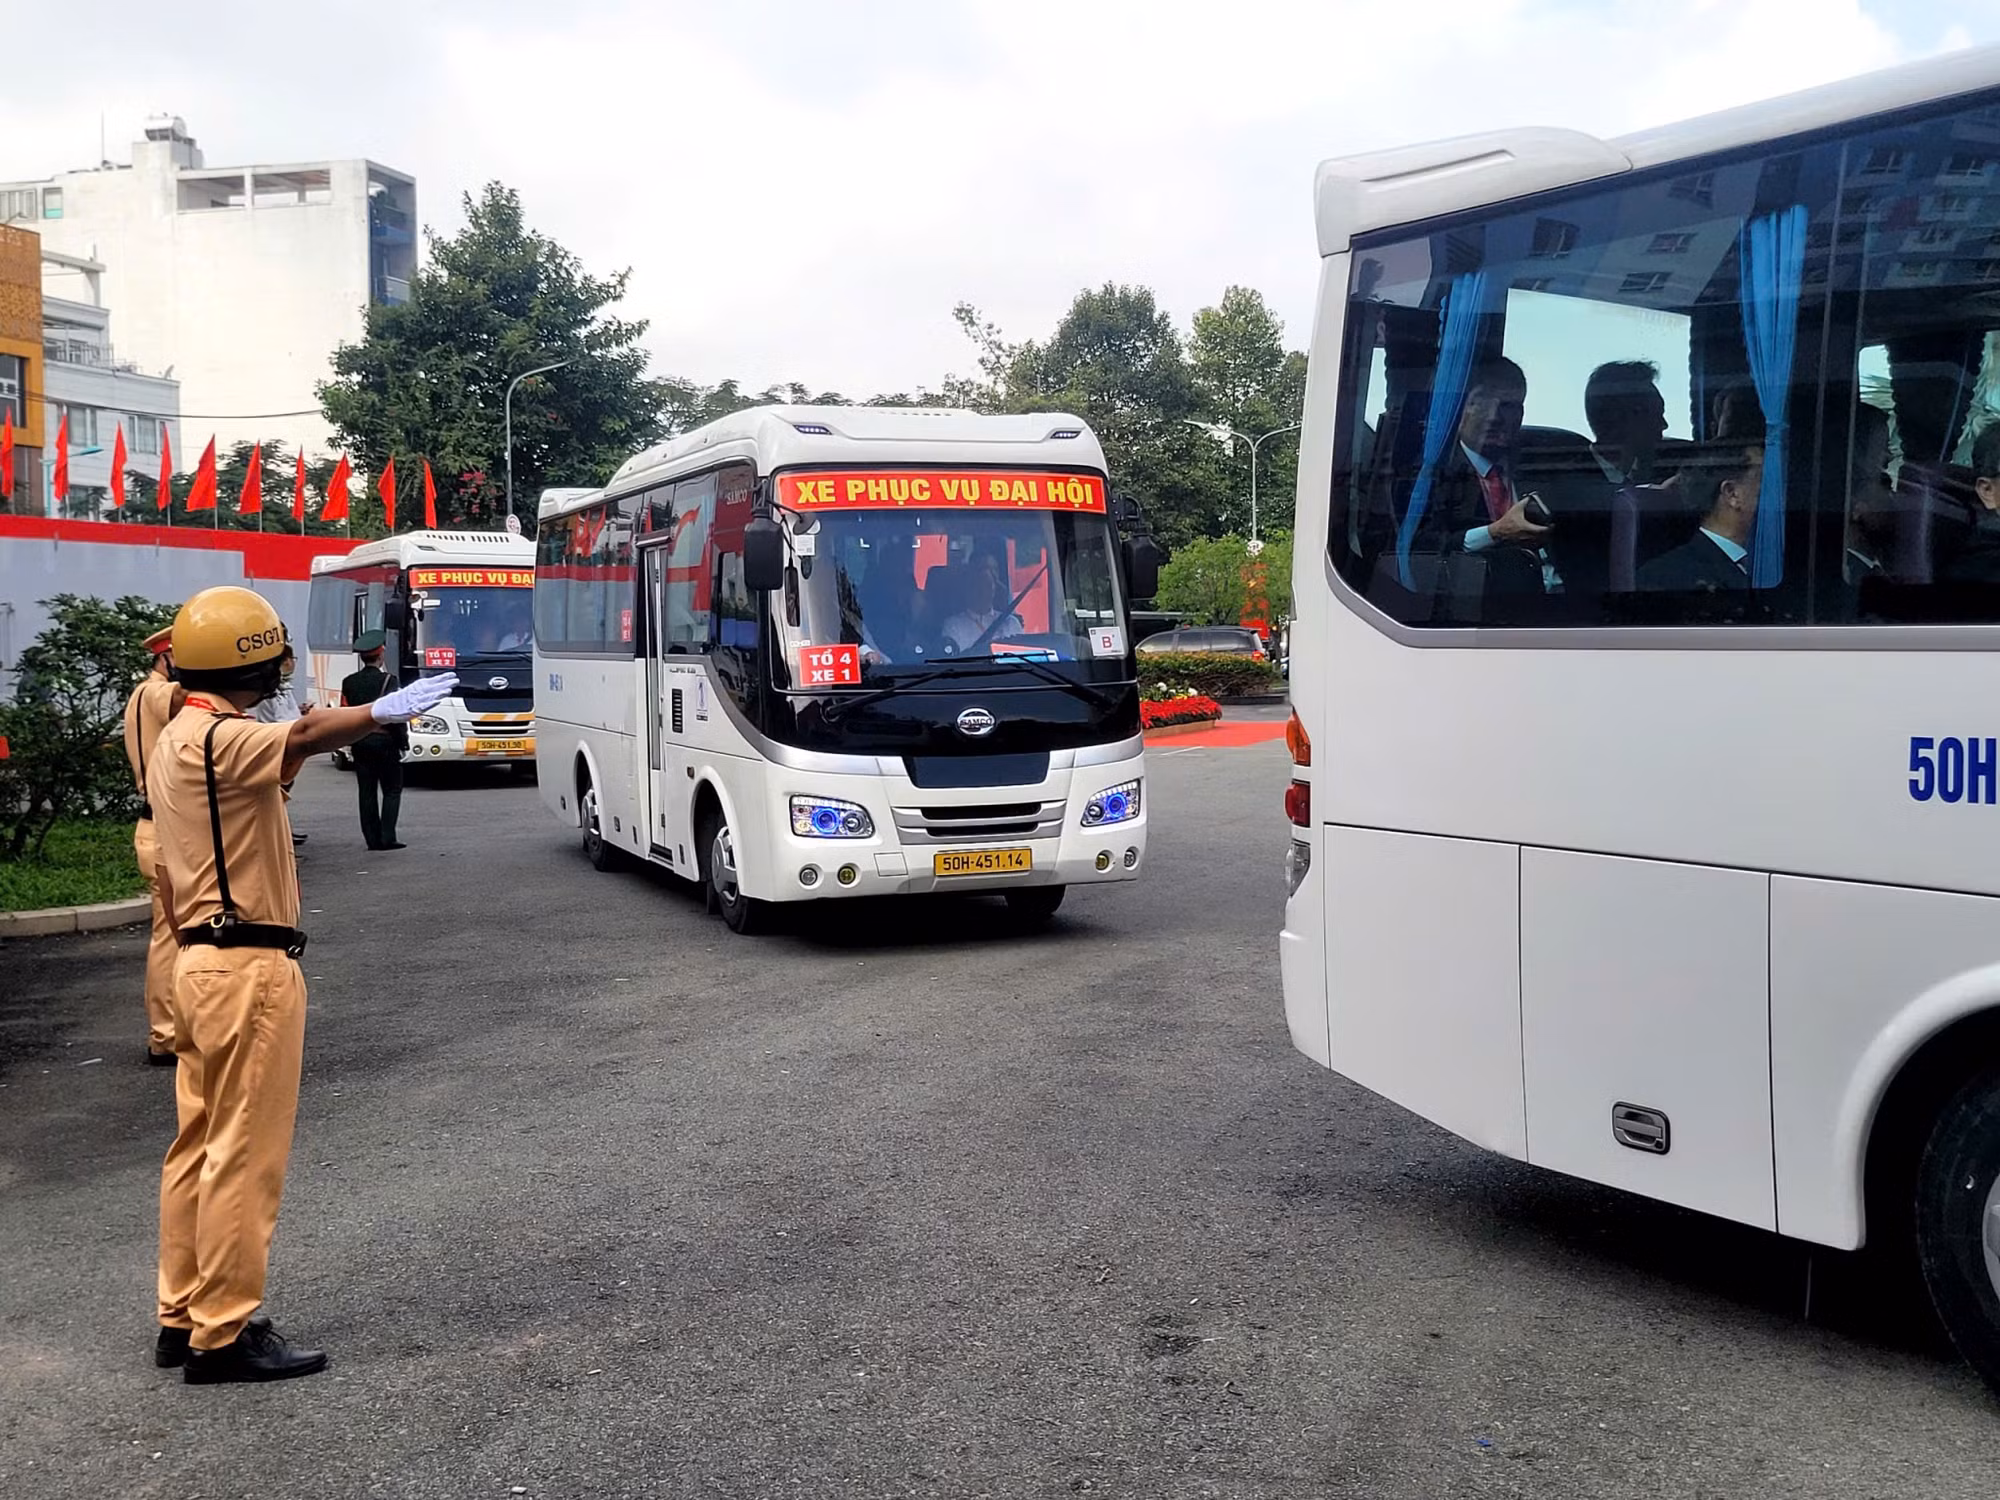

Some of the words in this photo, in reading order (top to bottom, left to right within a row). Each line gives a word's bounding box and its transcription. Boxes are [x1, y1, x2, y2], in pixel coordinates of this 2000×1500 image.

[796, 480, 836, 504] XE
[846, 478, 931, 506] PHỤC
[939, 479, 981, 506] VỤ
[989, 480, 1038, 506] ĐẠI
[1047, 477, 1094, 508] HỘI
[418, 572, 437, 584] XE
[441, 572, 483, 586] PHỤC
[487, 573, 508, 586] VỤ
[428, 650, 440, 658] TỔ
[809, 648, 834, 666] TỔ
[840, 652, 852, 665] 4
[811, 669, 835, 682] XE
[841, 668, 850, 681] 1
[1908, 736, 1997, 805] 50H
[943, 853, 1024, 871] 50H-451.14
